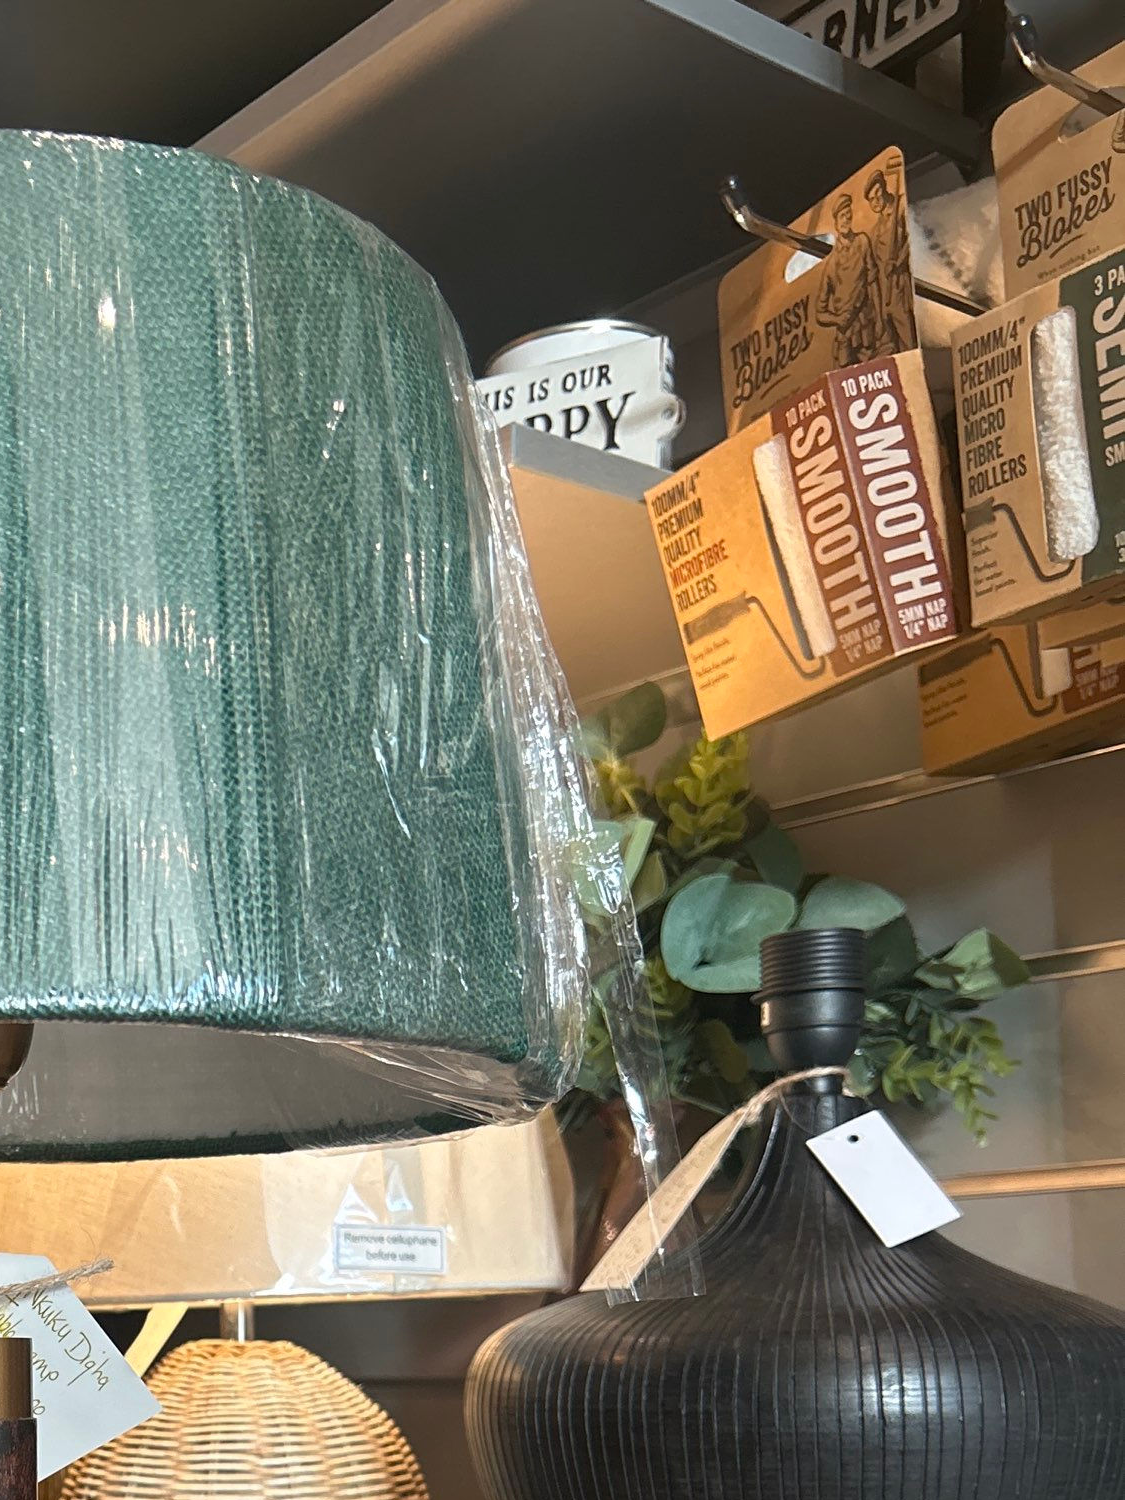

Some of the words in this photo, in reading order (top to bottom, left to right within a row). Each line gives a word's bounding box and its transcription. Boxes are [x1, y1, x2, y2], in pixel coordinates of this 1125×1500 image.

[1014, 190, 1052, 230] TWO
[1056, 156, 1112, 209] FUSSY
[1016, 187, 1116, 268] Blokes
[1094, 274, 1104, 296] 3
[730, 330, 761, 370] TWO
[764, 294, 810, 349] FUSSY
[528, 378, 550, 403] IS
[562, 364, 612, 394] OUR
[733, 325, 814, 409] Blokes
[841, 378, 857, 398] 10
[859, 369, 893, 395] PACK
[960, 344, 1023, 395] PREMIUM
[785, 407, 798, 428] 10
[798, 389, 828, 417] PACK
[962, 376, 1015, 422] QUALITY
[963, 407, 1006, 446] MICRO
[966, 438, 1004, 473] FIBRE
[968, 454, 1028, 500] ROLLERS
[657, 497, 704, 542] PREMIUM
[847, 392, 944, 605] SMOOTH
[789, 414, 877, 632] SMOOTH
[663, 525, 702, 568] QUALITY
[669, 539, 729, 590] MICROFIBRE
[675, 573, 717, 612] ROLLERS
[897, 604, 925, 625] 5MM
[925, 598, 946, 617] NAP
[927, 613, 948, 632] NAP
[344, 1232, 385, 1245] Remove
[366, 1250, 397, 1262] before
[399, 1252, 416, 1262] use
